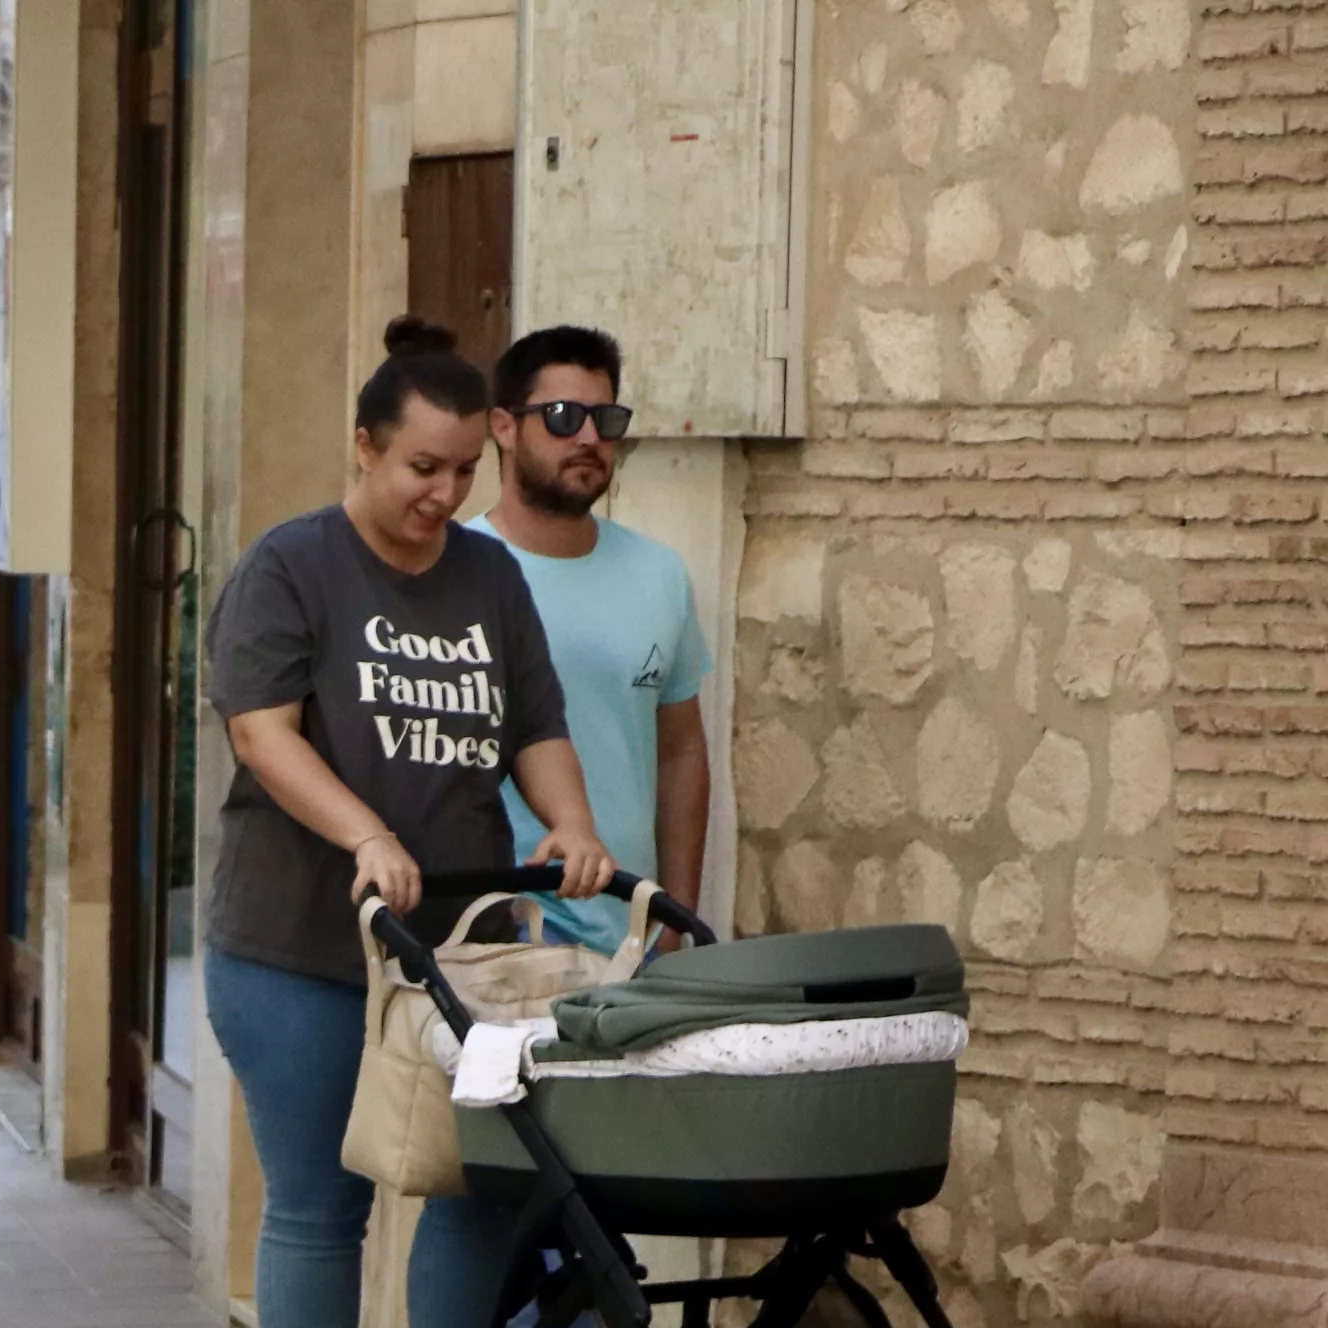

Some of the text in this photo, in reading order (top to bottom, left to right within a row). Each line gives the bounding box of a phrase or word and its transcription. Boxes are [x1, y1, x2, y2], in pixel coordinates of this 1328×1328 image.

[364, 615, 493, 664] Good
[357, 661, 505, 727] Family
[374, 715, 500, 769] Vibes
